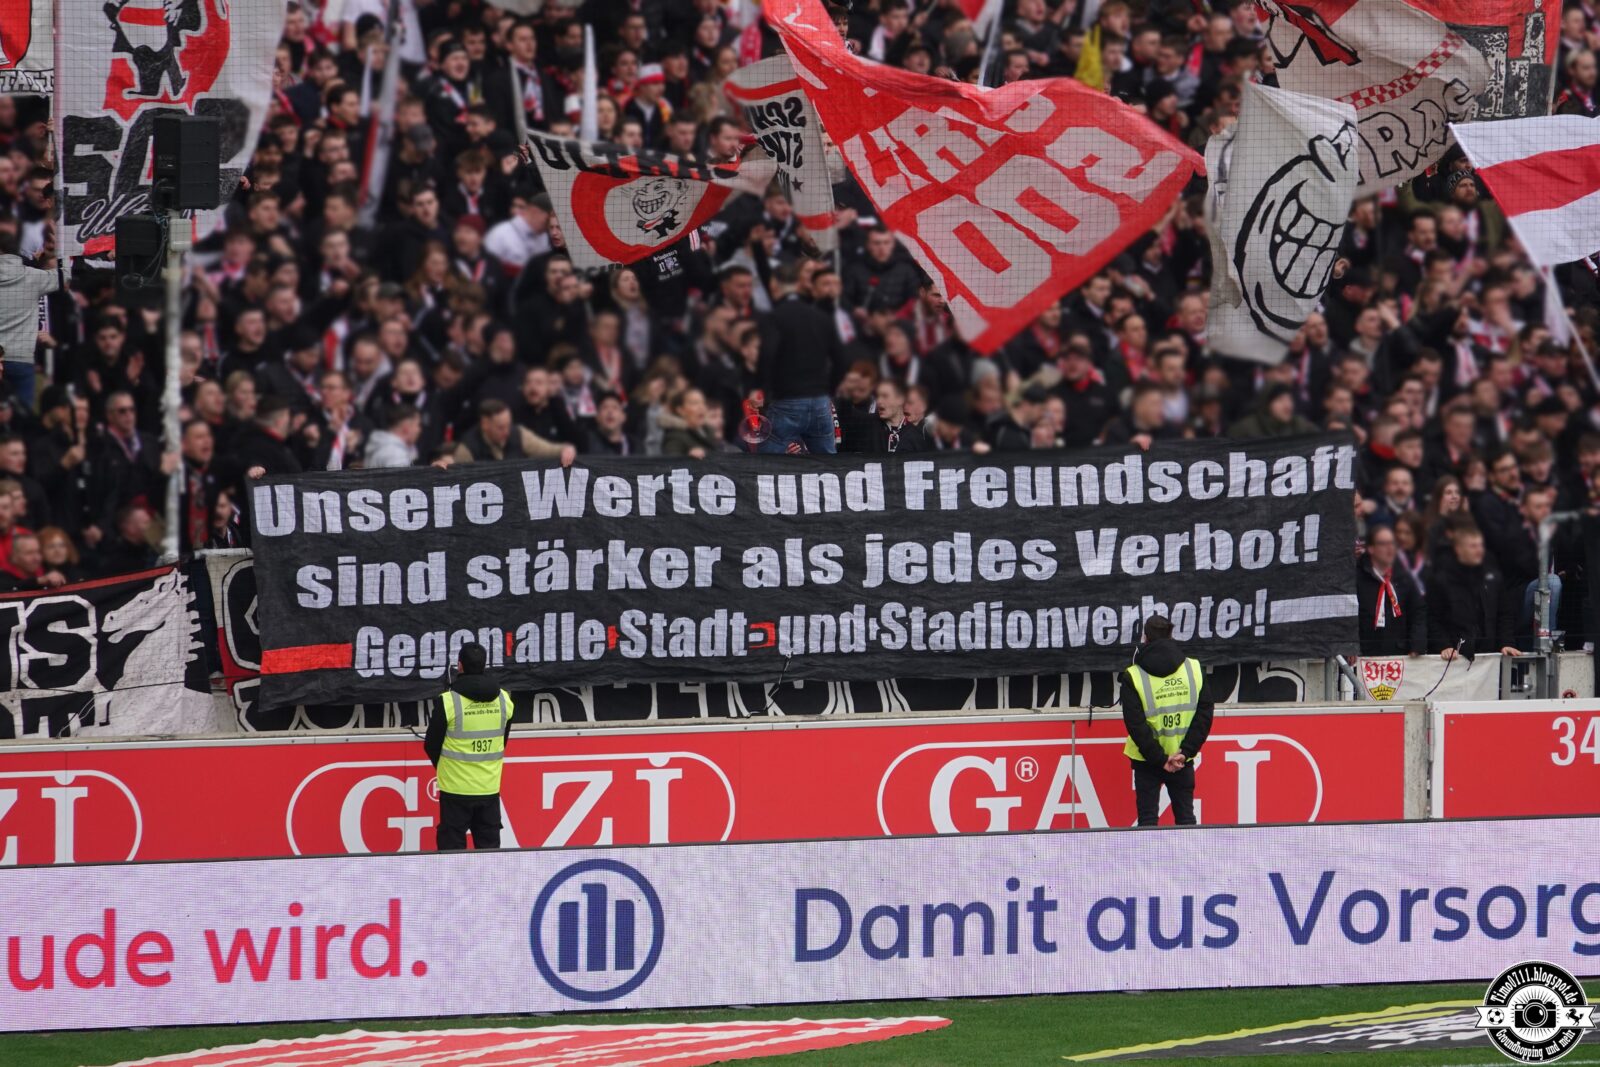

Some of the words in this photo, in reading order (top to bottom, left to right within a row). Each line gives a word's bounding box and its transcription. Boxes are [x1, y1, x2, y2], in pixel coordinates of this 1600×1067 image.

[253, 482, 504, 537] Unsere
[521, 467, 737, 521] Werte
[757, 462, 885, 515] und
[904, 445, 1357, 511] Freundschaft
[296, 552, 446, 609] sind
[466, 539, 721, 599] stärker
[742, 538, 844, 589] als
[862, 532, 1058, 589] jedes
[1075, 514, 1320, 577] Verbot!
[354, 625, 504, 679] Gegen
[515, 612, 606, 663] alle
[778, 604, 867, 656] und
[471, 739, 493, 753] 1937
[7, 907, 175, 992] ude
[204, 898, 428, 984] wird.
[795, 877, 1058, 963] Damit
[1087, 893, 1240, 952] aus
[1268, 870, 1600, 956] Vorsorg
